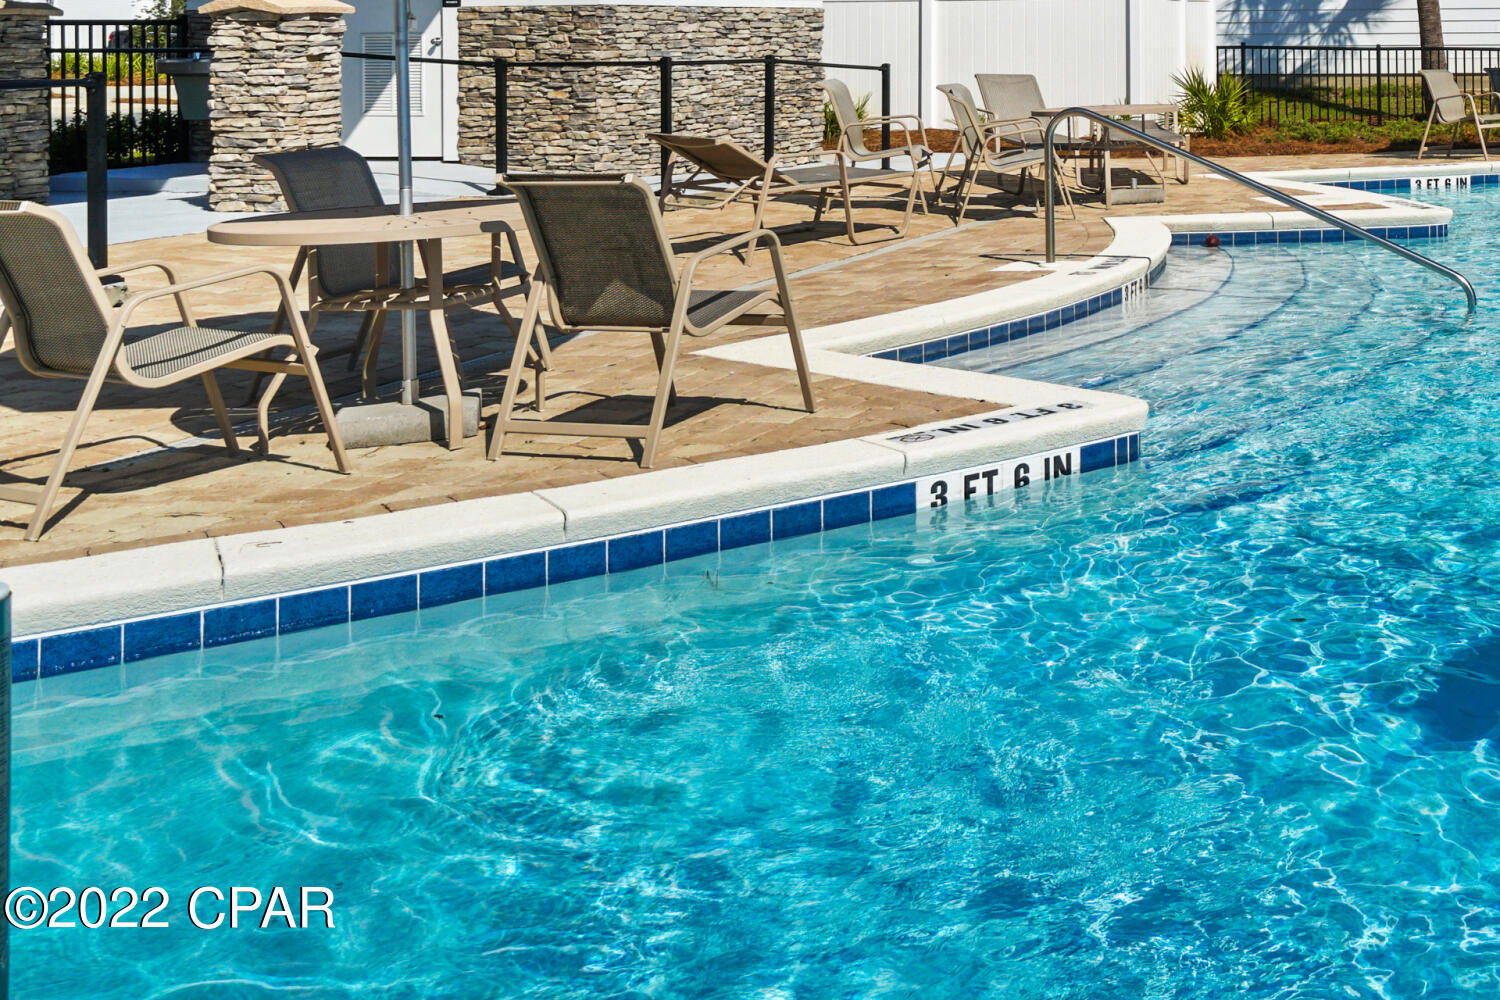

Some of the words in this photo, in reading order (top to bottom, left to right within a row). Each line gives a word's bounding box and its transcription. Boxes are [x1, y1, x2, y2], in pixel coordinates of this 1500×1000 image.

[1456, 177, 1467, 190] IN
[930, 480, 948, 508] 3
[964, 469, 999, 500] FT
[1014, 463, 1030, 489] 6
[1044, 452, 1072, 481] IN
